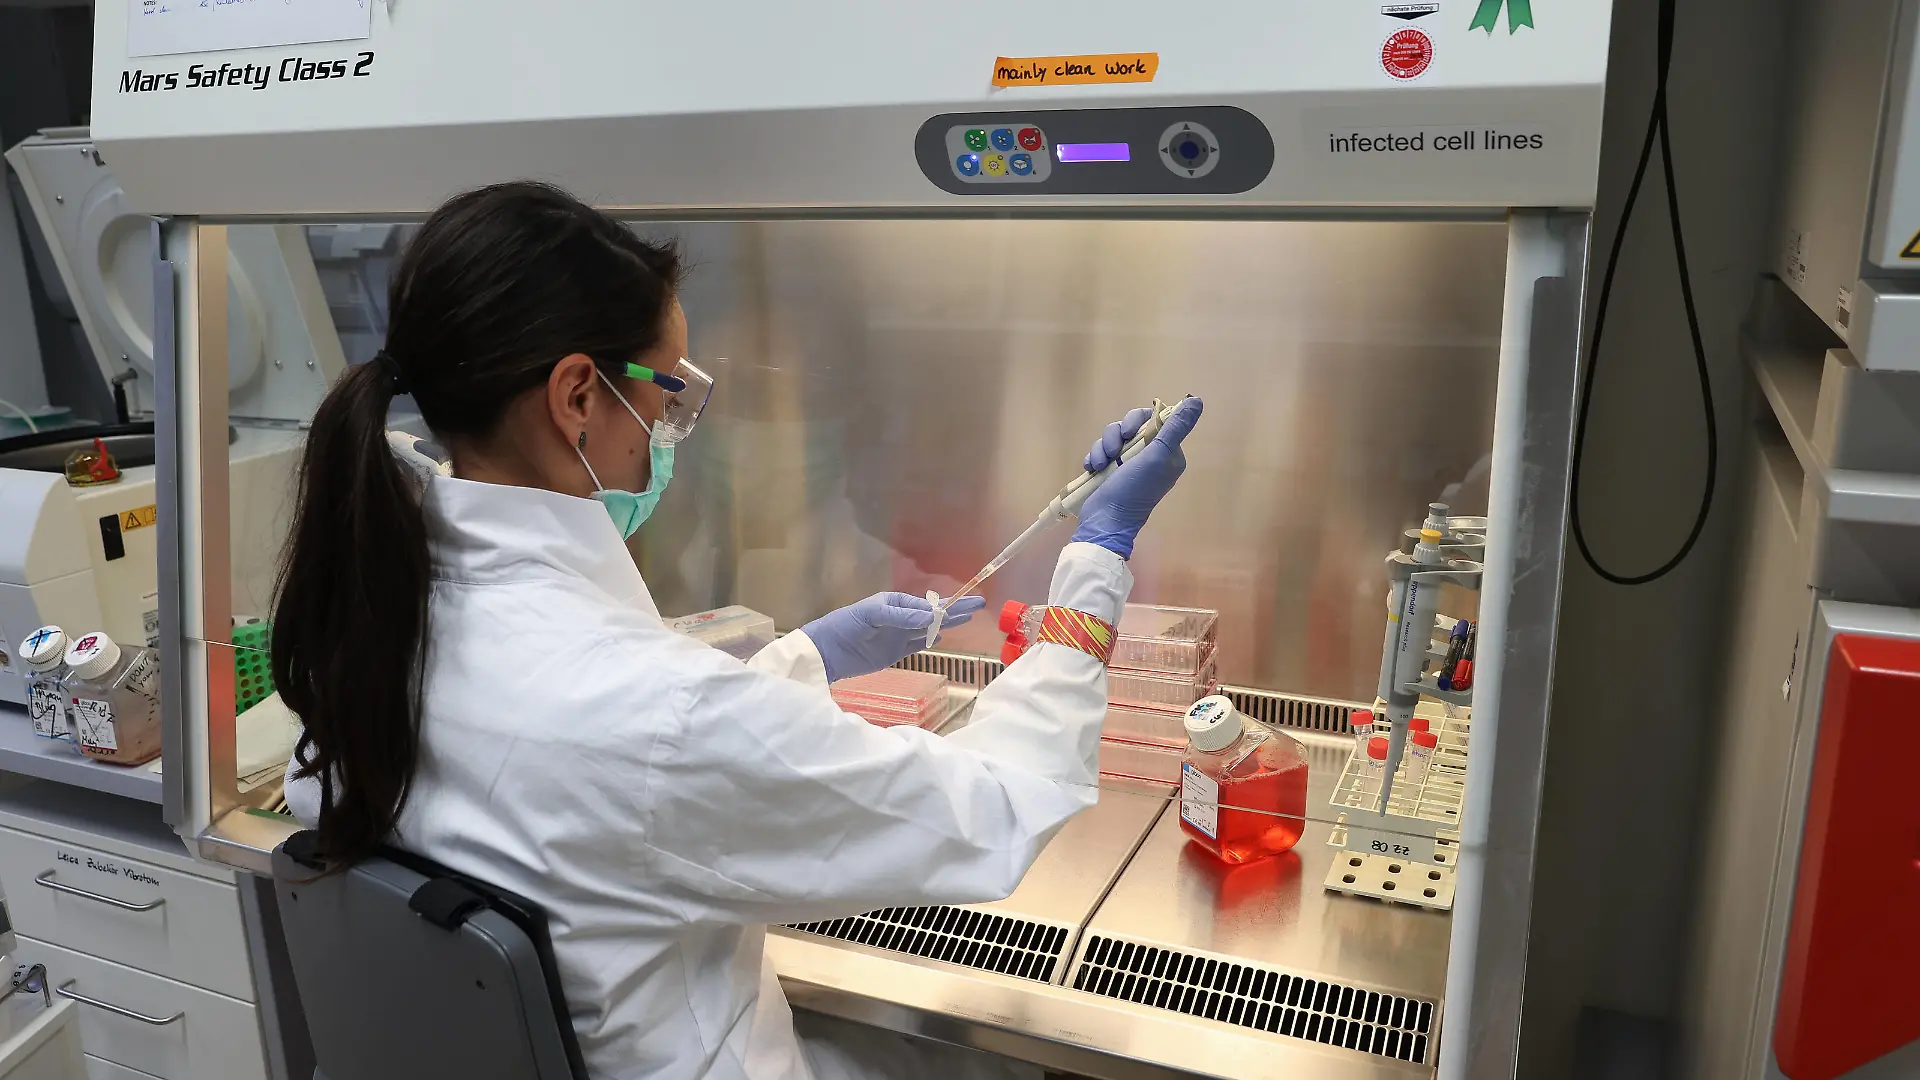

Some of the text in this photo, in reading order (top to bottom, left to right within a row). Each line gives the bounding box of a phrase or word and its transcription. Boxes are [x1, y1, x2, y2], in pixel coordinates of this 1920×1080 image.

[119, 51, 375, 93] Mars Safety Class 2
[997, 62, 1047, 82] mainly
[1054, 61, 1096, 76] clean
[1329, 130, 1543, 153] infected cell lines
[1408, 580, 1419, 616] eppendorf
[57, 850, 79, 865] Leica
